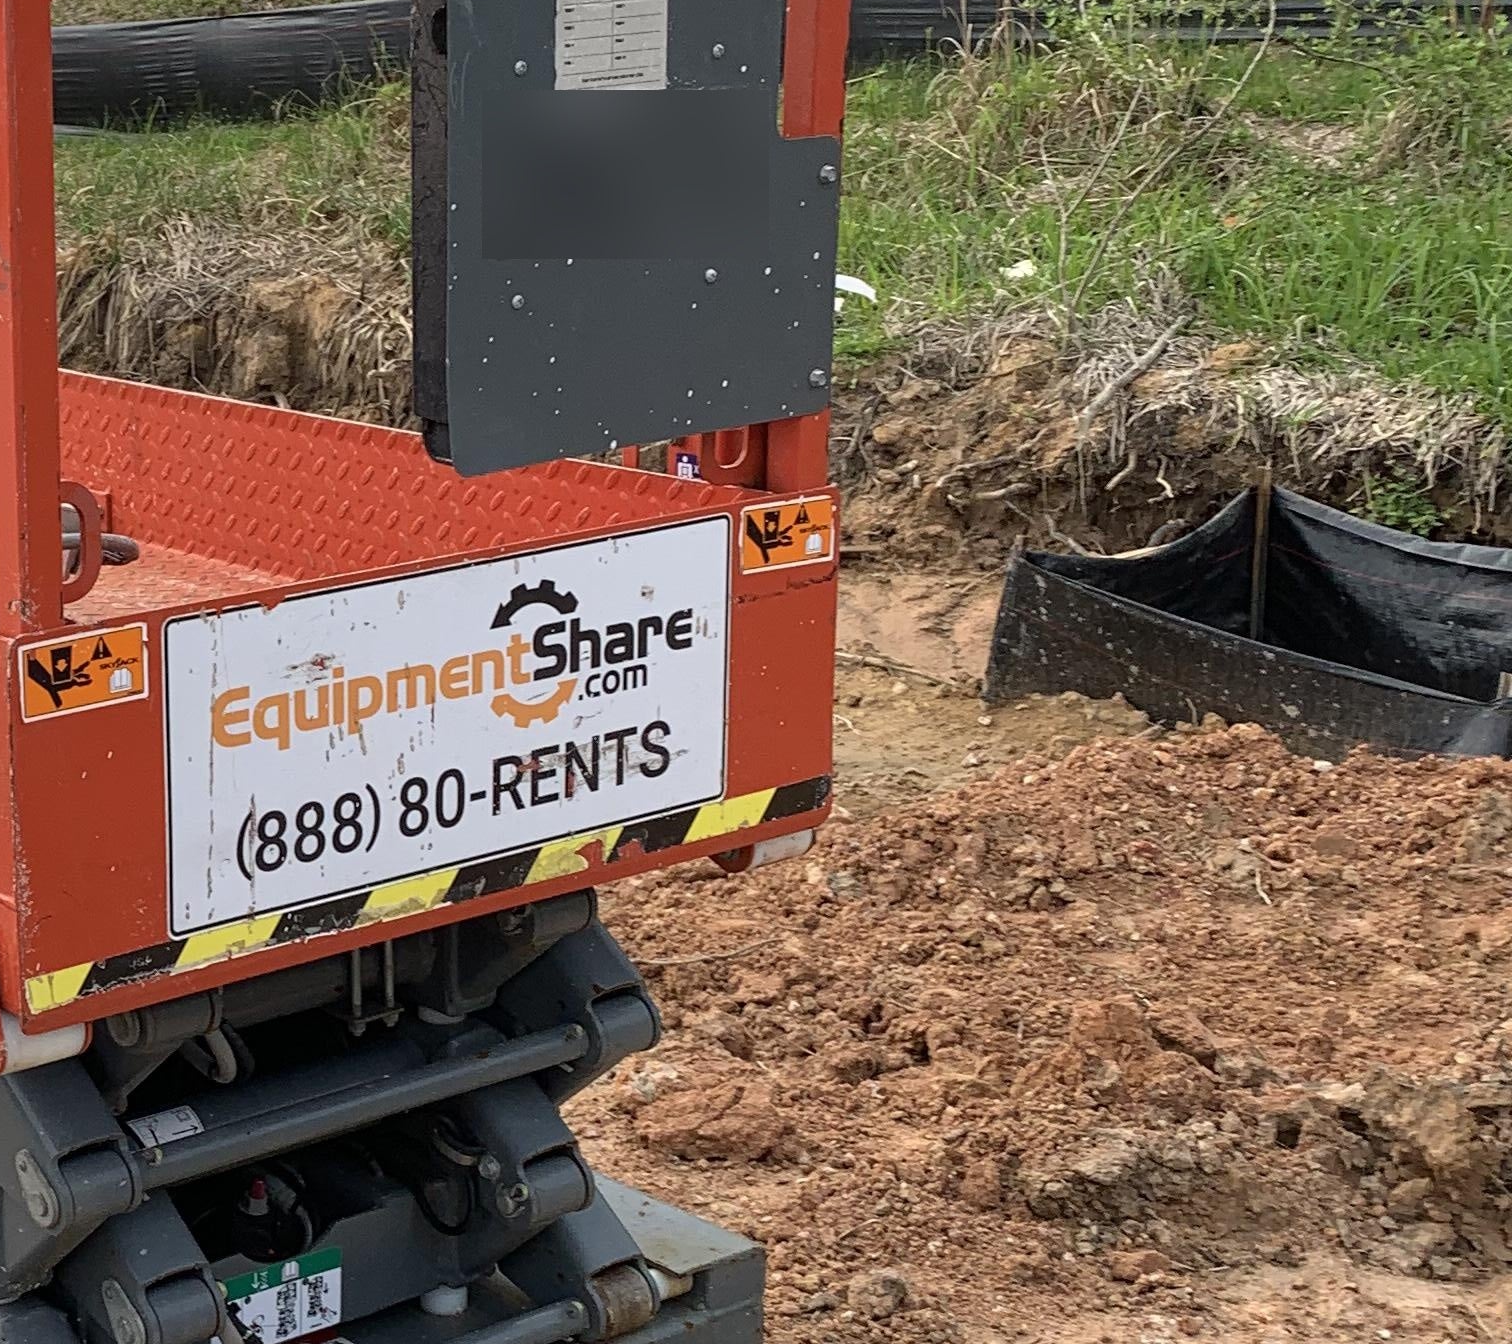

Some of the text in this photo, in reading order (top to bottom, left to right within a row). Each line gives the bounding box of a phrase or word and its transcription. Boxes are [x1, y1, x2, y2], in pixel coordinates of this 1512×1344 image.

[212, 608, 694, 751] EquipmentShare
[576, 662, 648, 702] .com
[236, 718, 674, 882] (888) 80-RENTS
